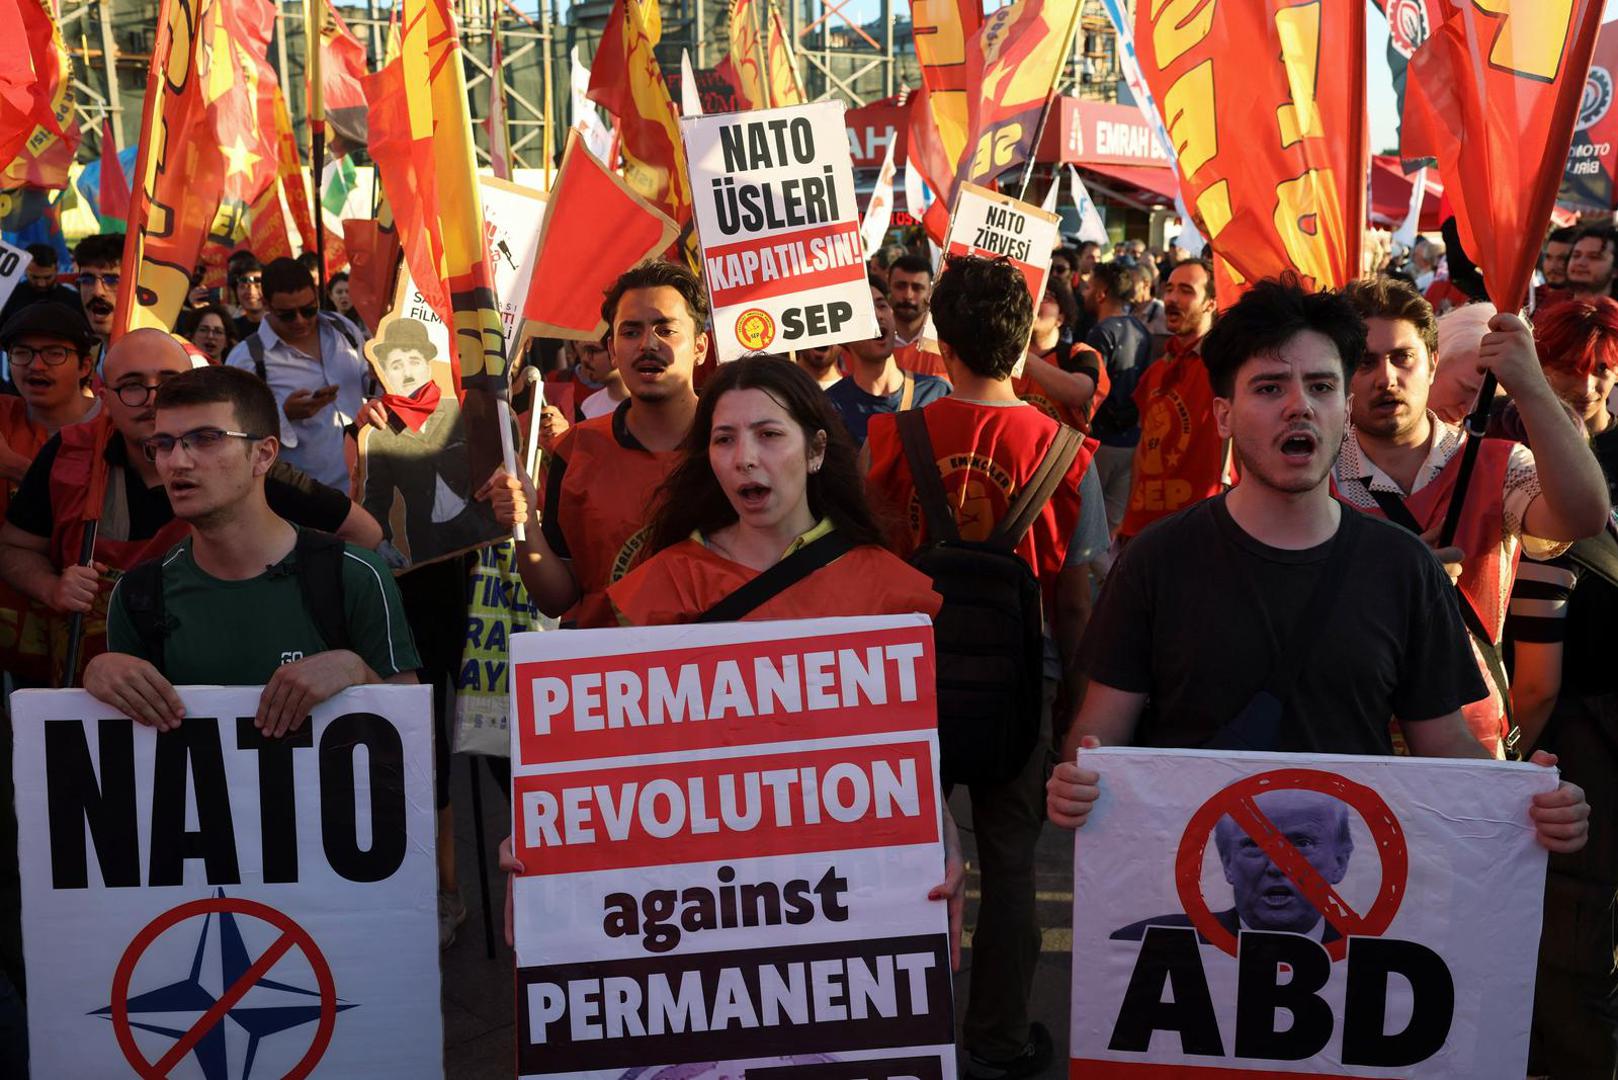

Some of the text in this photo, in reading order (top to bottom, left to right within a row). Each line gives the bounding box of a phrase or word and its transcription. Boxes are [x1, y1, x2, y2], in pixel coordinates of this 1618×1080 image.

[719, 117, 816, 173] NATO
[1096, 120, 1149, 158] EMRAH
[712, 165, 840, 236] ÜSLERİ
[985, 205, 1025, 235] NATO
[707, 231, 862, 292] KAPATILSIN!
[973, 226, 1032, 262] ZİRVESİ
[781, 301, 853, 340] SEP
[531, 642, 924, 736] PERMANENT
[44, 712, 408, 889] NATO
[522, 758, 921, 849] REVOLUTION
[602, 865, 849, 953] against
[527, 951, 936, 1046] PERMANENT
[1106, 925, 1455, 1067] ABD
